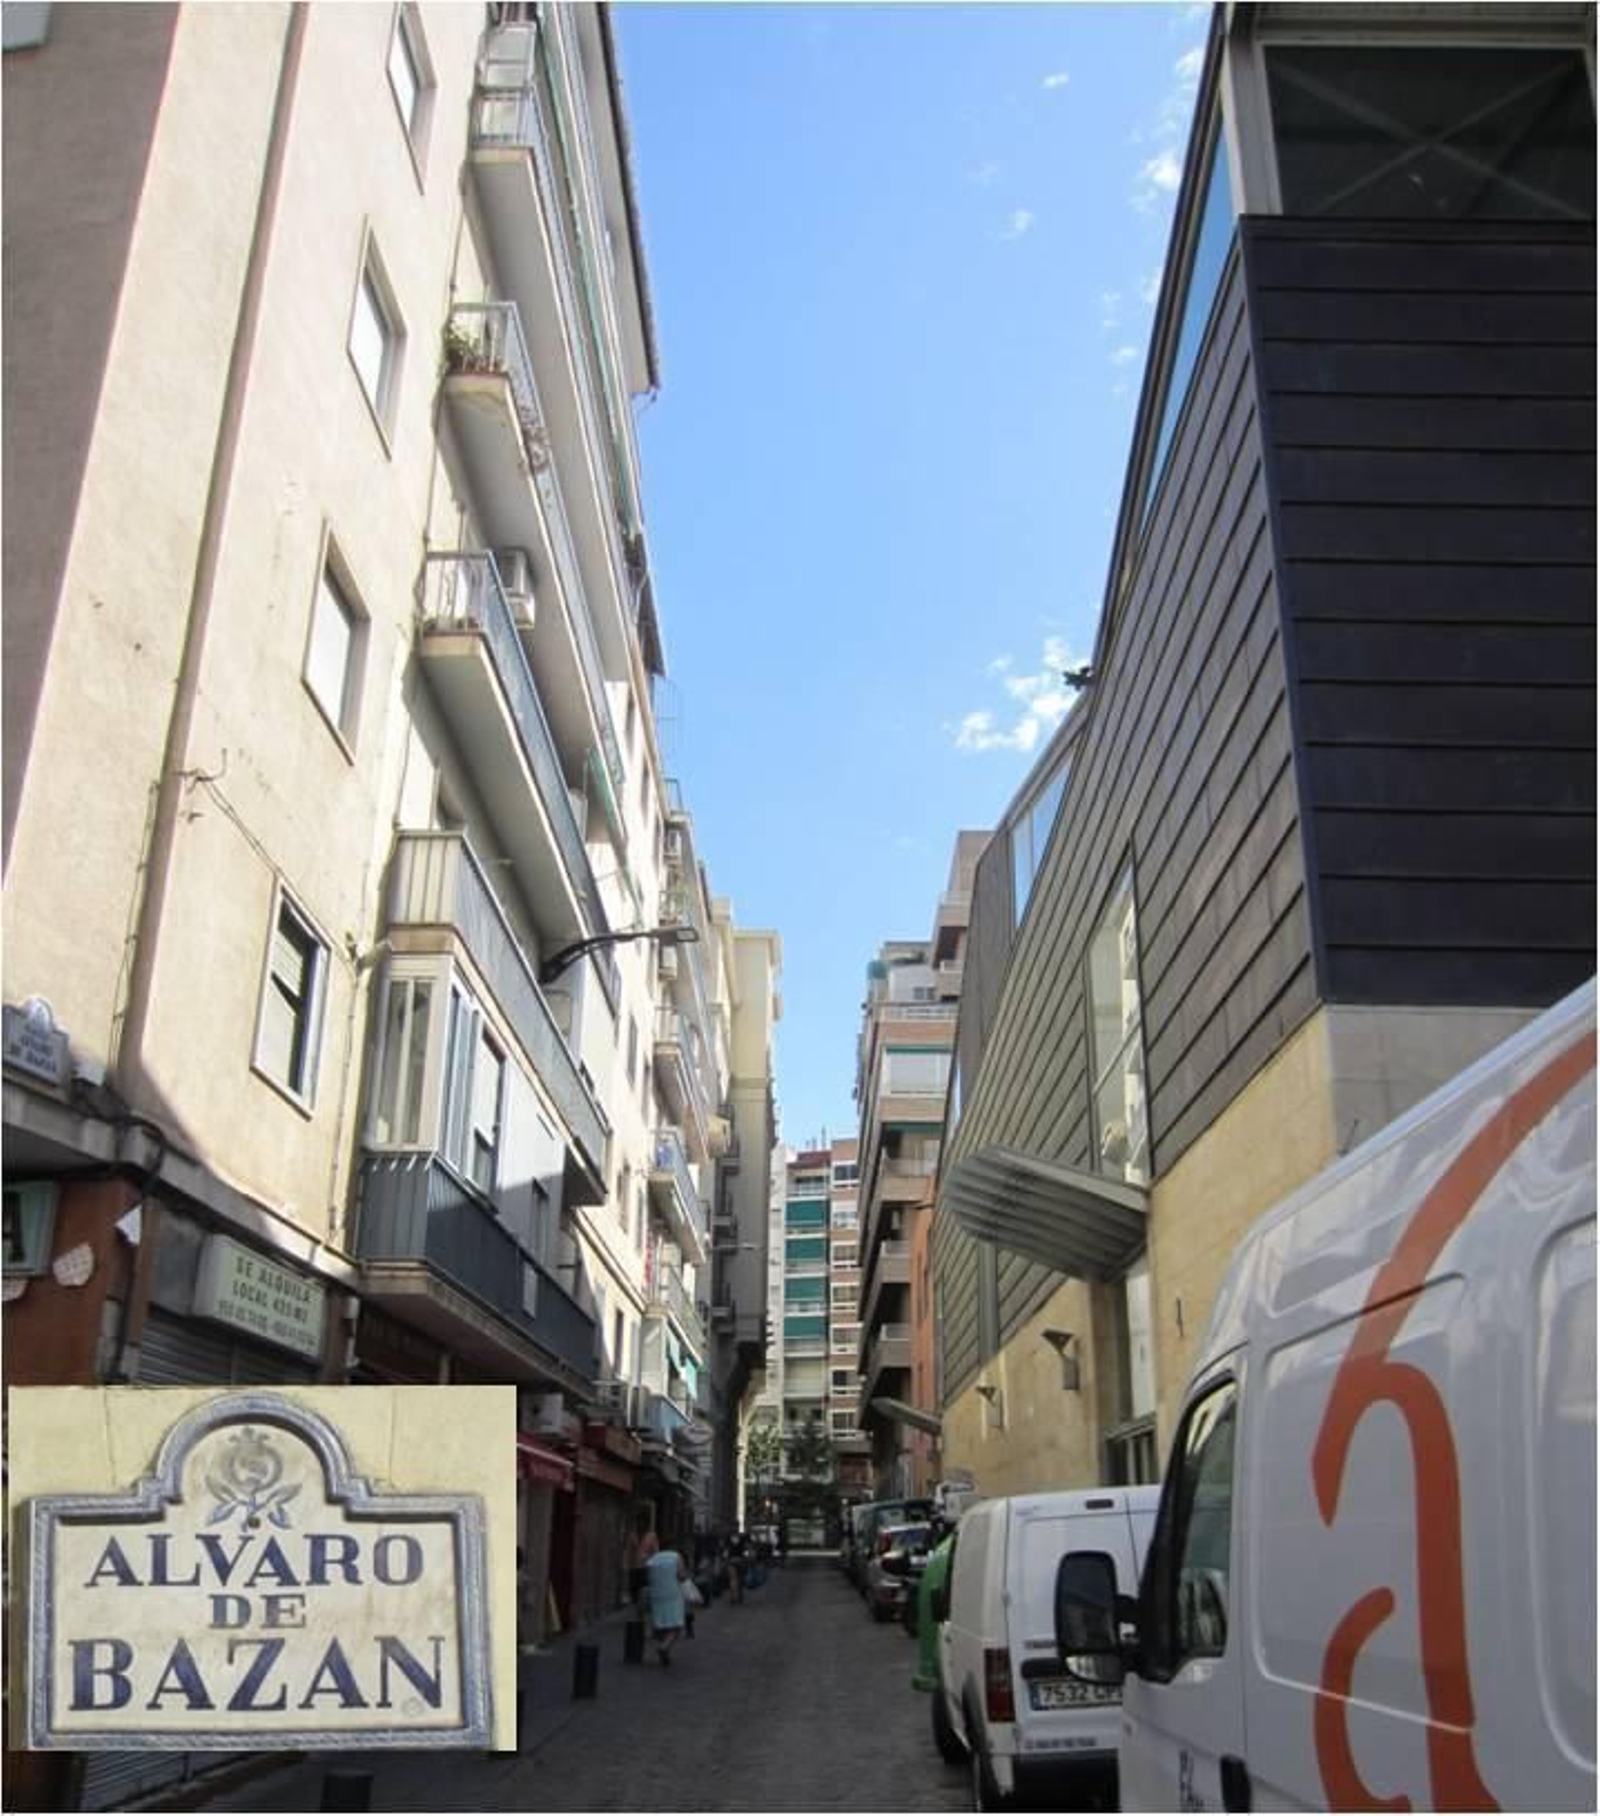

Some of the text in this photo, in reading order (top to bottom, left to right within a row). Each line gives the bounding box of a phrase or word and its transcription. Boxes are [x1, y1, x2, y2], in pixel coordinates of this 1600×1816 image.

[231, 1279, 268, 1309] LOCAL
[258, 1266, 312, 1304] ALQUILA
[84, 1533, 424, 1588] ALVARO
[208, 1593, 308, 1630] DE
[67, 1636, 446, 1712] BAZAN
